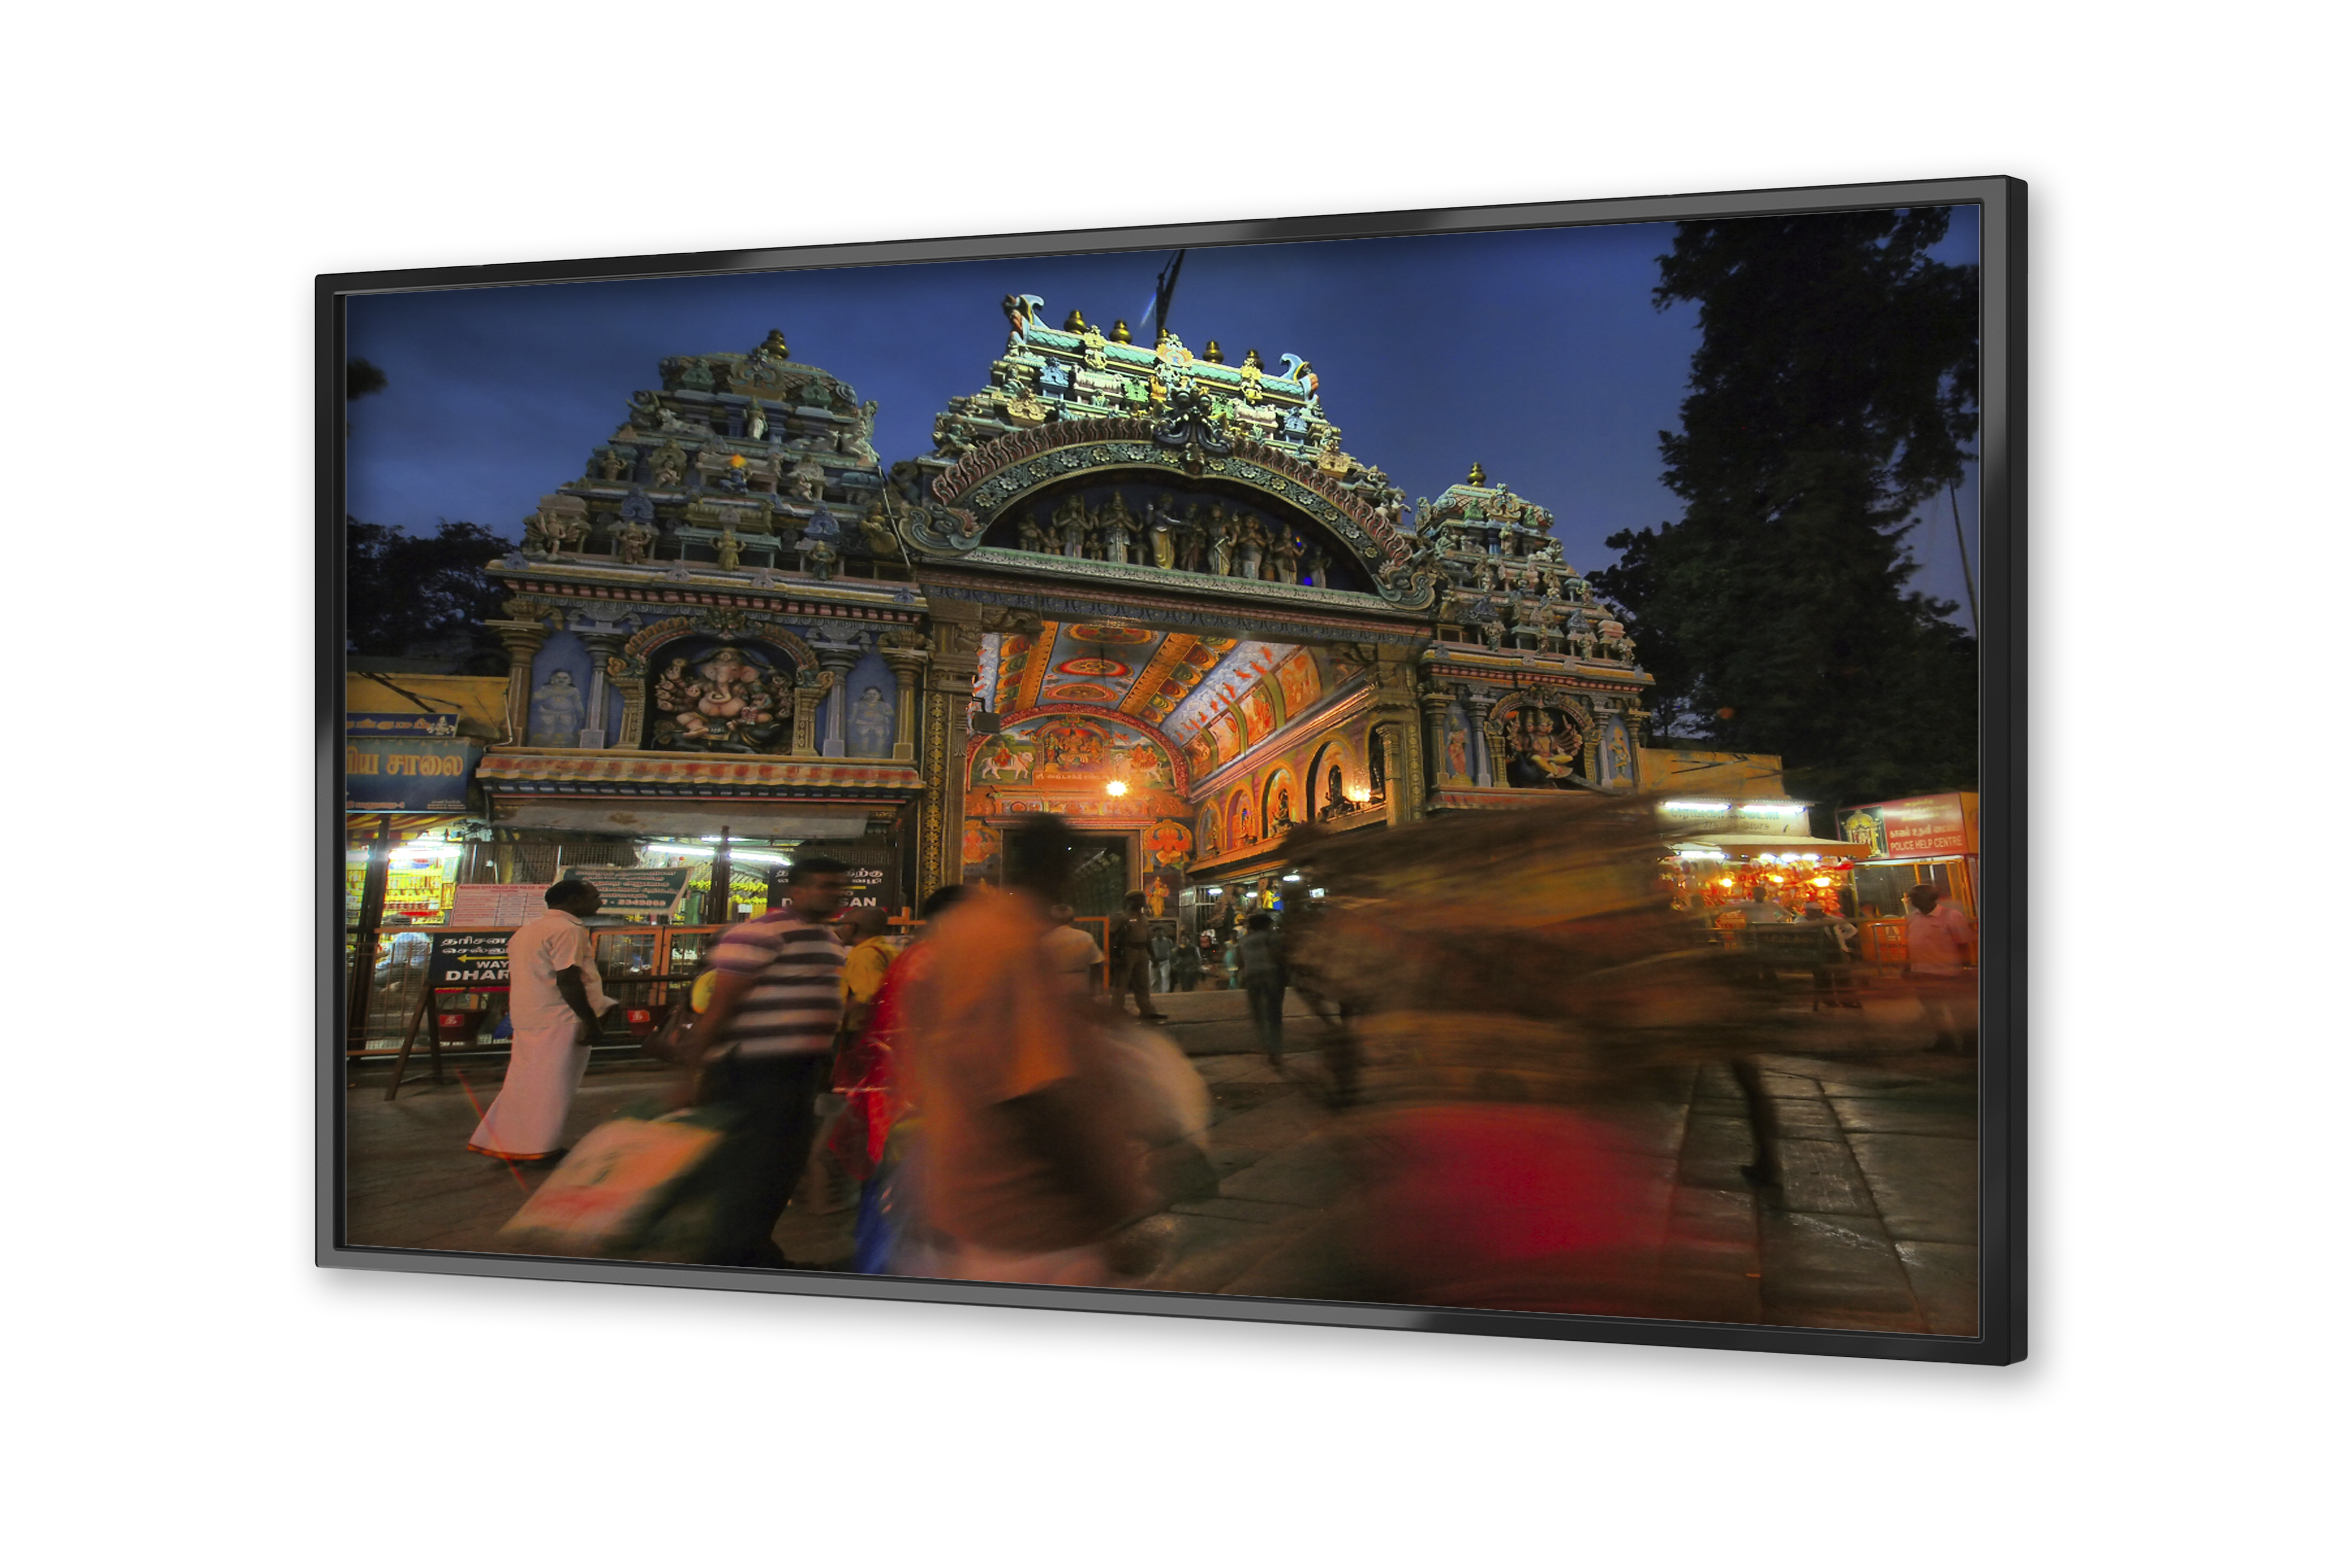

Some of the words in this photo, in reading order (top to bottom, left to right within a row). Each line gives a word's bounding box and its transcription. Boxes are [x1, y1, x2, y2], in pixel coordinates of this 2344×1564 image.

[386, 754, 464, 776] சாலை
[1890, 841, 1914, 851] POLICE
[1915, 839, 1933, 849] HELP
[1934, 836, 1963, 848] CENTRE
[476, 961, 510, 969] WAY
[445, 970, 510, 981] DHAR
